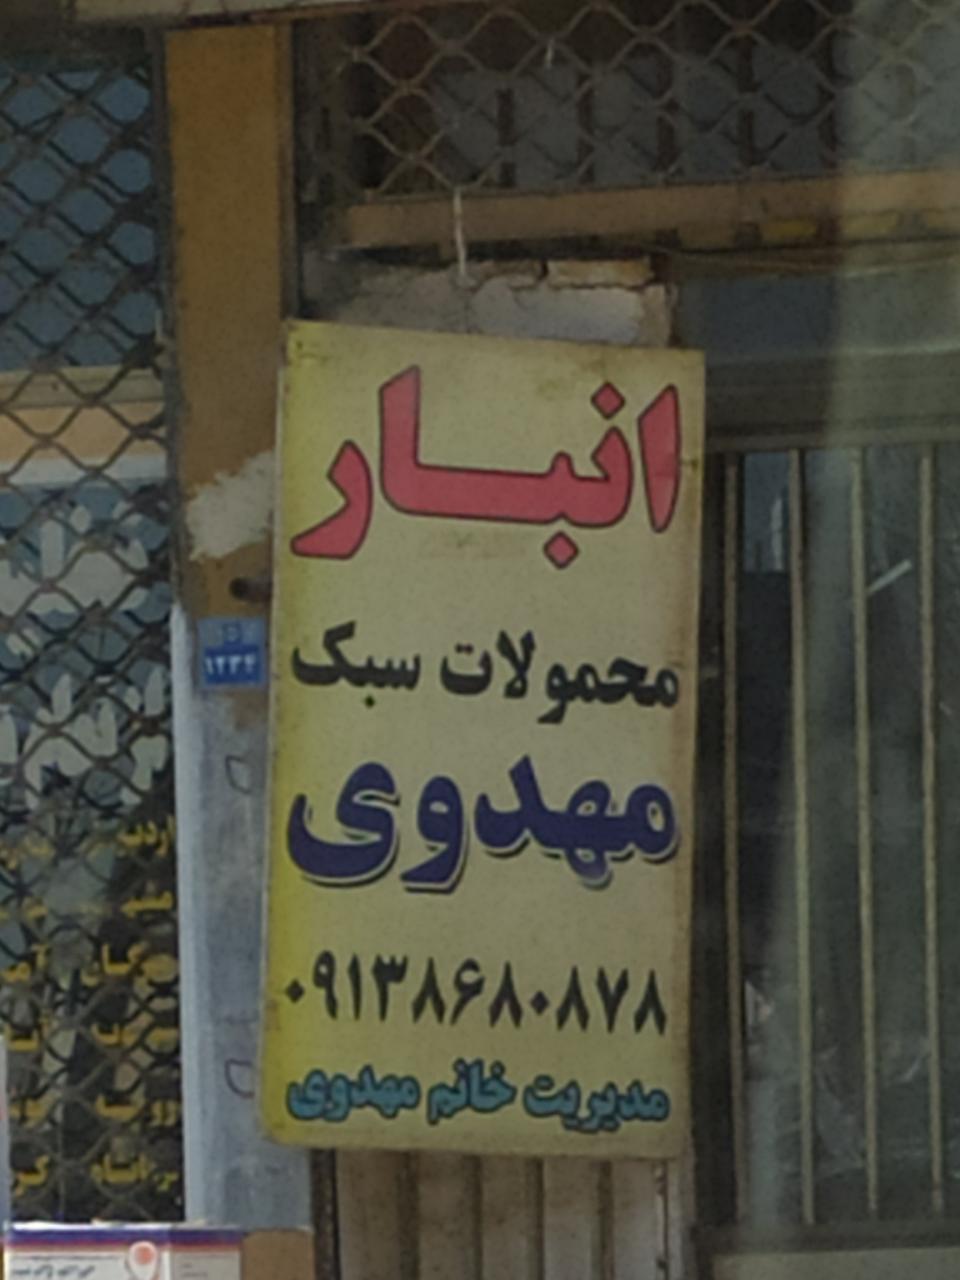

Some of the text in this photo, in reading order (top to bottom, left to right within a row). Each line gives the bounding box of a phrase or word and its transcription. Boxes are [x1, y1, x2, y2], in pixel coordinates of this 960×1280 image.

[290, 364, 683, 570] انبار
[291, 620, 679, 724] محمولات سبک
[286, 755, 681, 895] مهدوی
[284, 949, 668, 1036] ۰۹۱۳۸۶۸۰۸۷۸
[286, 1057, 672, 1132] مدیریت خانم مهدوی
